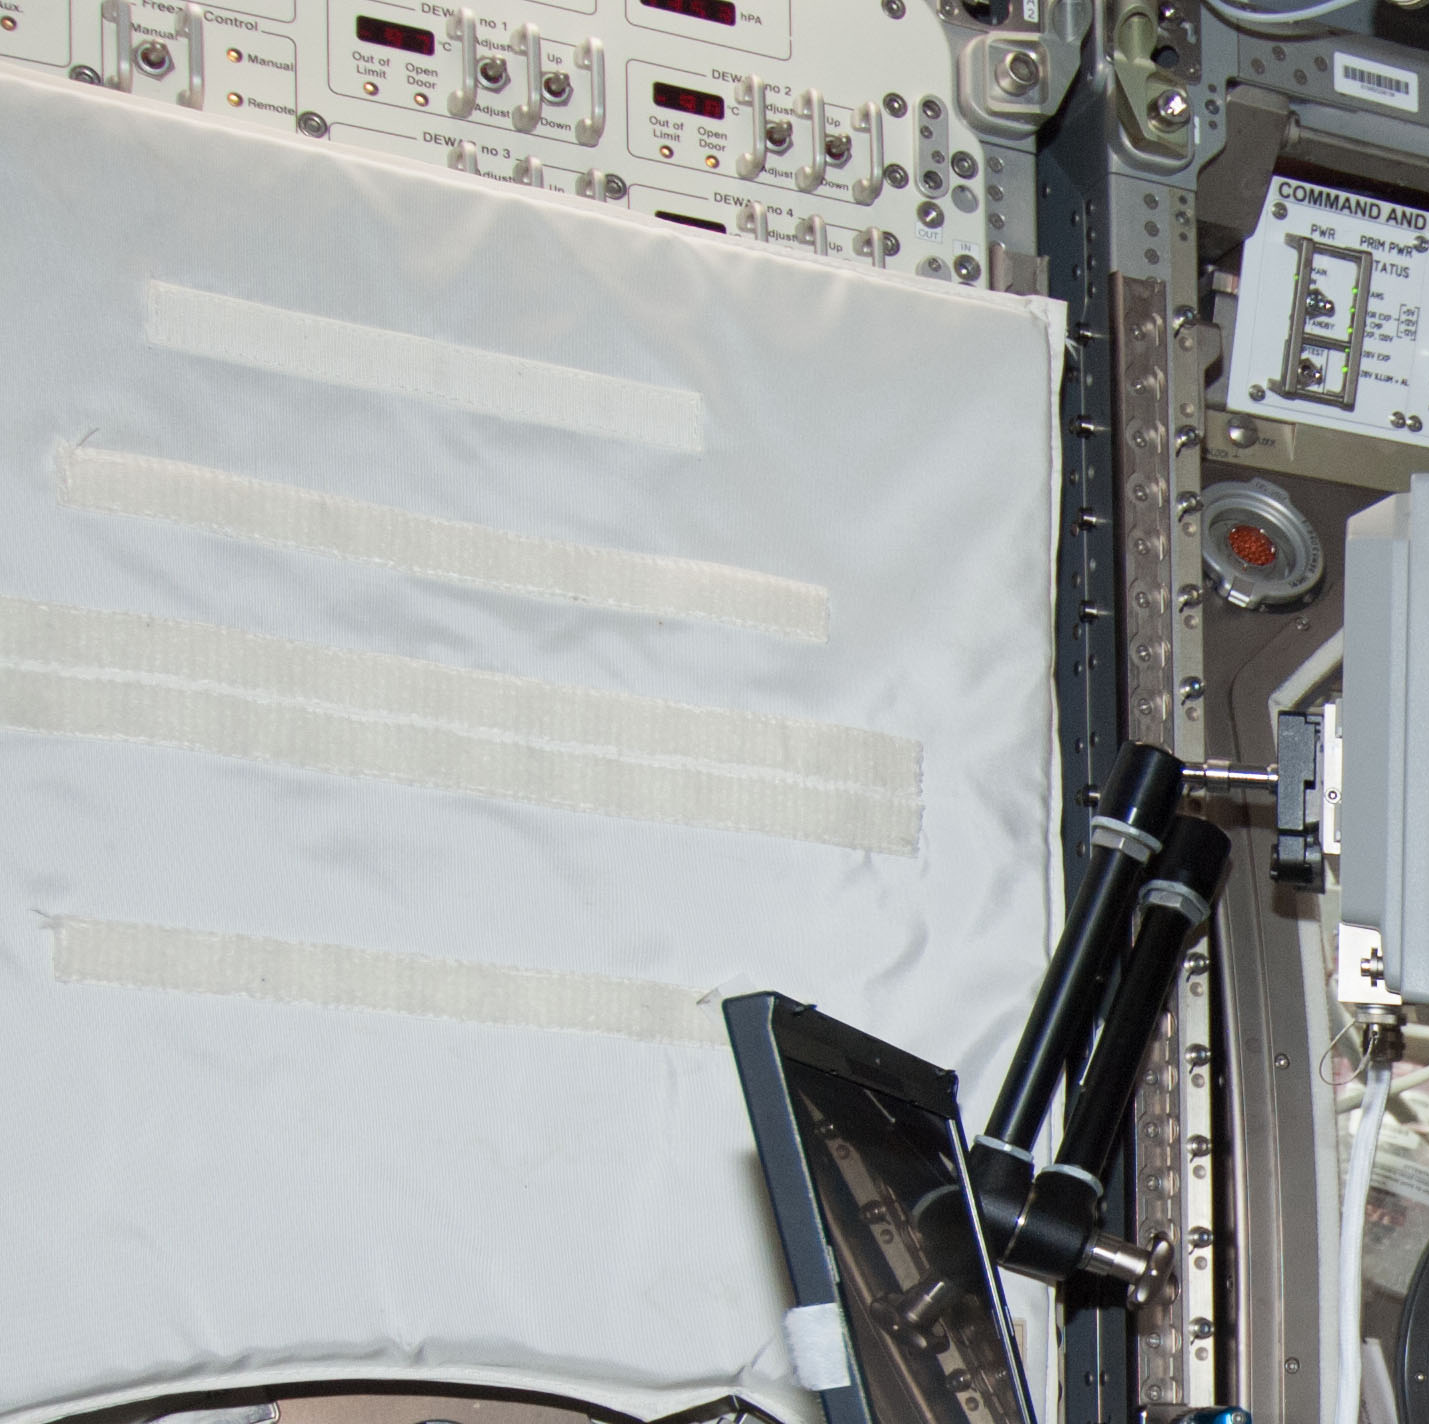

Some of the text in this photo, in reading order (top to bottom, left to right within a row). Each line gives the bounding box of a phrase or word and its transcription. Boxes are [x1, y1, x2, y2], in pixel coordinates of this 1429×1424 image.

[203, 10, 259, 32] Control
[421, 2, 508, 32] DEW no 1
[740, 12, 763, 26] hPA
[247, 52, 294, 73] Manual
[352, 51, 391, 67] Out of
[547, 53, 563, 65] Up
[356, 64, 388, 80] Limit
[405, 62, 439, 78] Open
[407, 76, 437, 91] Door
[711, 69, 793, 97] DEW no 2
[247, 97, 296, 117] Remote
[474, 103, 511, 119] Adjust
[765, 102, 794, 116] djust
[540, 117, 572, 132] Down
[649, 115, 684, 131] Out of
[826, 115, 842, 128] Up
[653, 128, 681, 143] Limit
[697, 126, 728, 141] Open
[481, 145, 499, 158] no
[503, 148, 511, 160] 3
[698, 139, 727, 152] Door
[821, 178, 850, 192] Down
[767, 205, 783, 216] no
[786, 208, 794, 218] 4
[1278, 181, 1382, 220] COMMAND
[1385, 208, 1428, 231] AND
[767, 229, 798, 243] djust
[918, 229, 940, 241] OUT
[1310, 223, 1336, 241] PWR
[828, 241, 844, 253] Up
[960, 242, 972, 252] IN
[1360, 234, 1414, 259] PRIM PWR
[1374, 259, 1411, 279] TATUS
